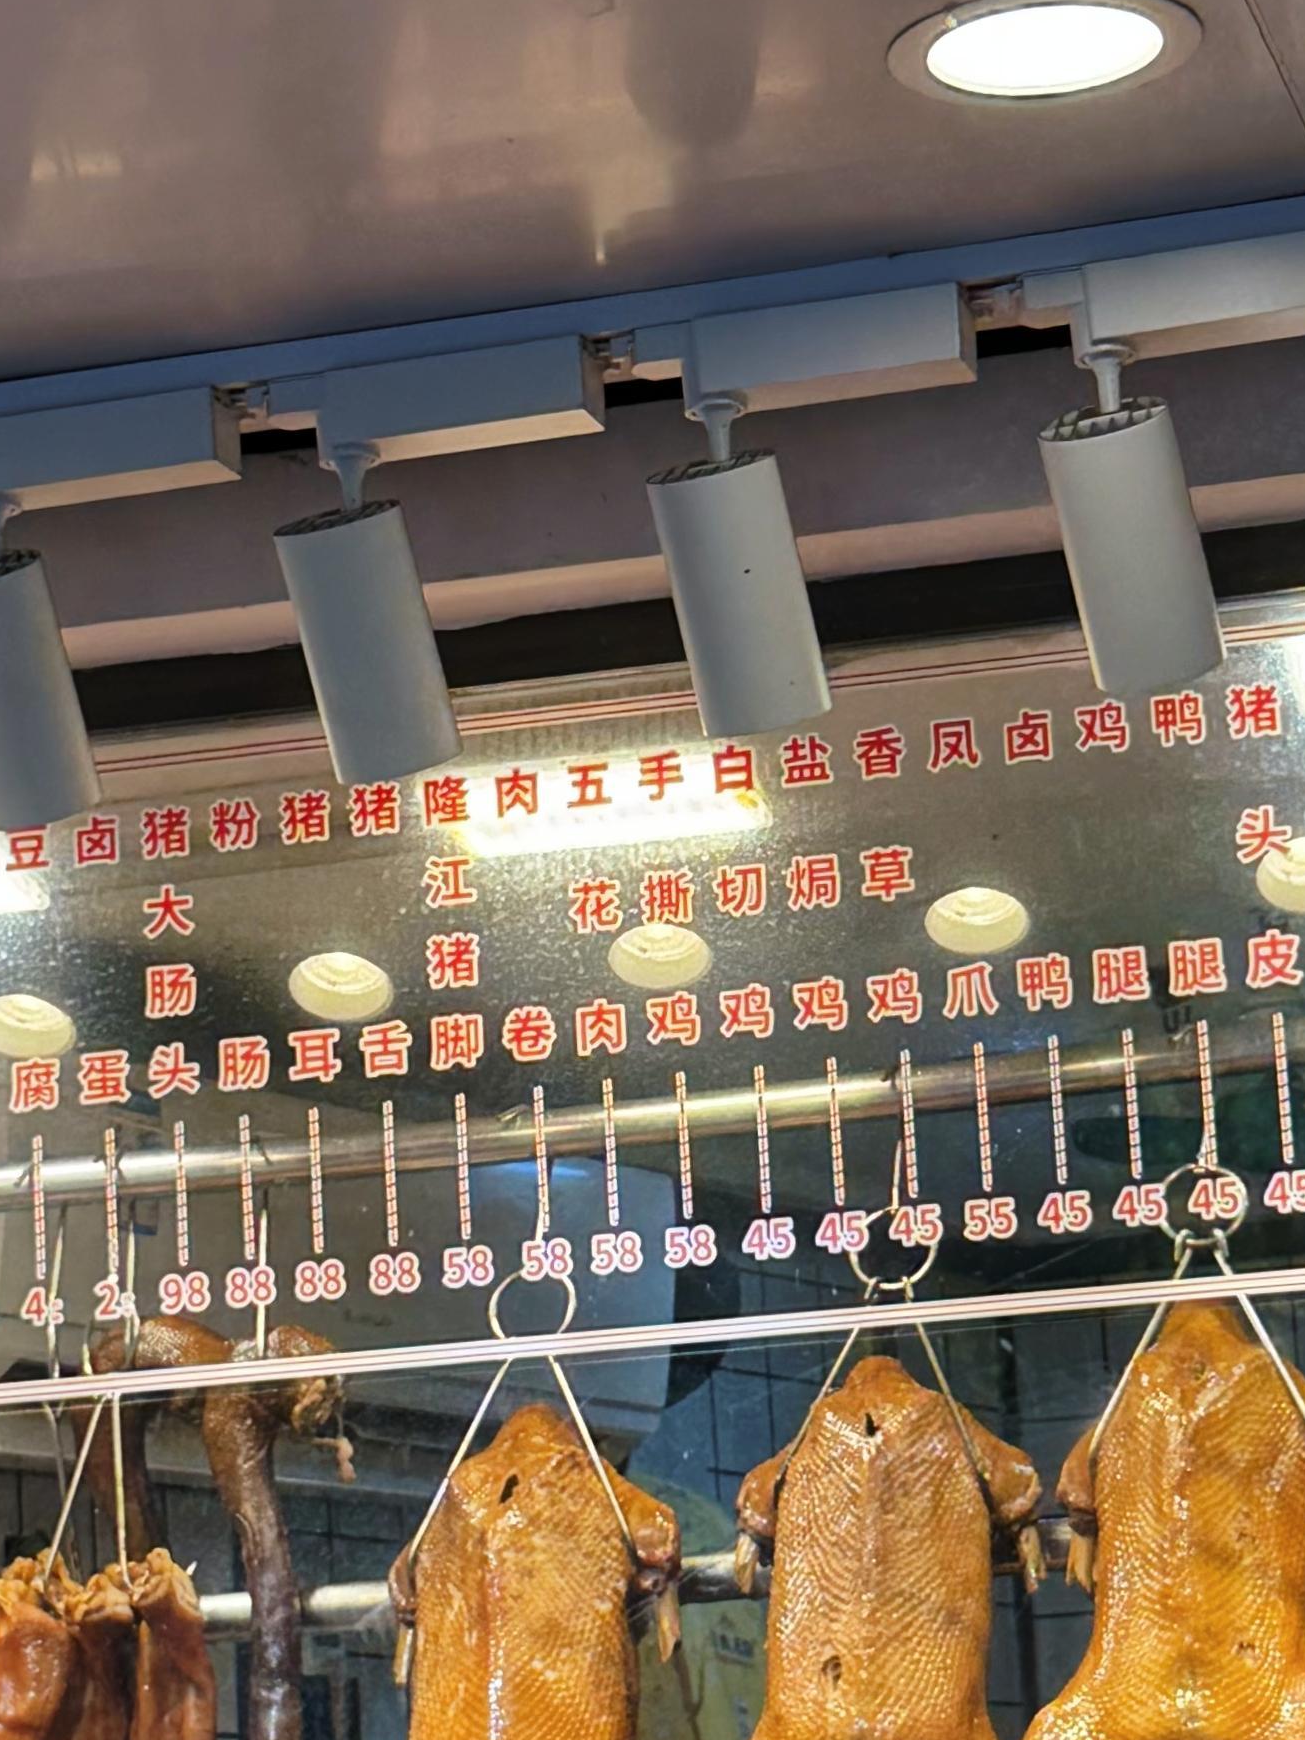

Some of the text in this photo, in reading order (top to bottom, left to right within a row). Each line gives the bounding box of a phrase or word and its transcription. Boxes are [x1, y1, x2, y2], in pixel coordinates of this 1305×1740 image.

[963, 1197, 1017, 1241] 55
[1037, 1190, 1092, 1233] 45
[1113, 1183, 1167, 1226] 45
[1188, 1177, 1243, 1220] 45
[665, 1225, 716, 1267] 58
[742, 1217, 796, 1260] 45
[815, 1211, 869, 1253] 45
[889, 1204, 943, 1247] 45
[369, 1252, 420, 1295] 88
[443, 1245, 493, 1288] 58
[522, 1238, 572, 1280] 58
[591, 1231, 642, 1274] 58
[159, 1272, 211, 1313] 98
[226, 1266, 276, 1308] 88
[296, 1259, 345, 1302] 88
